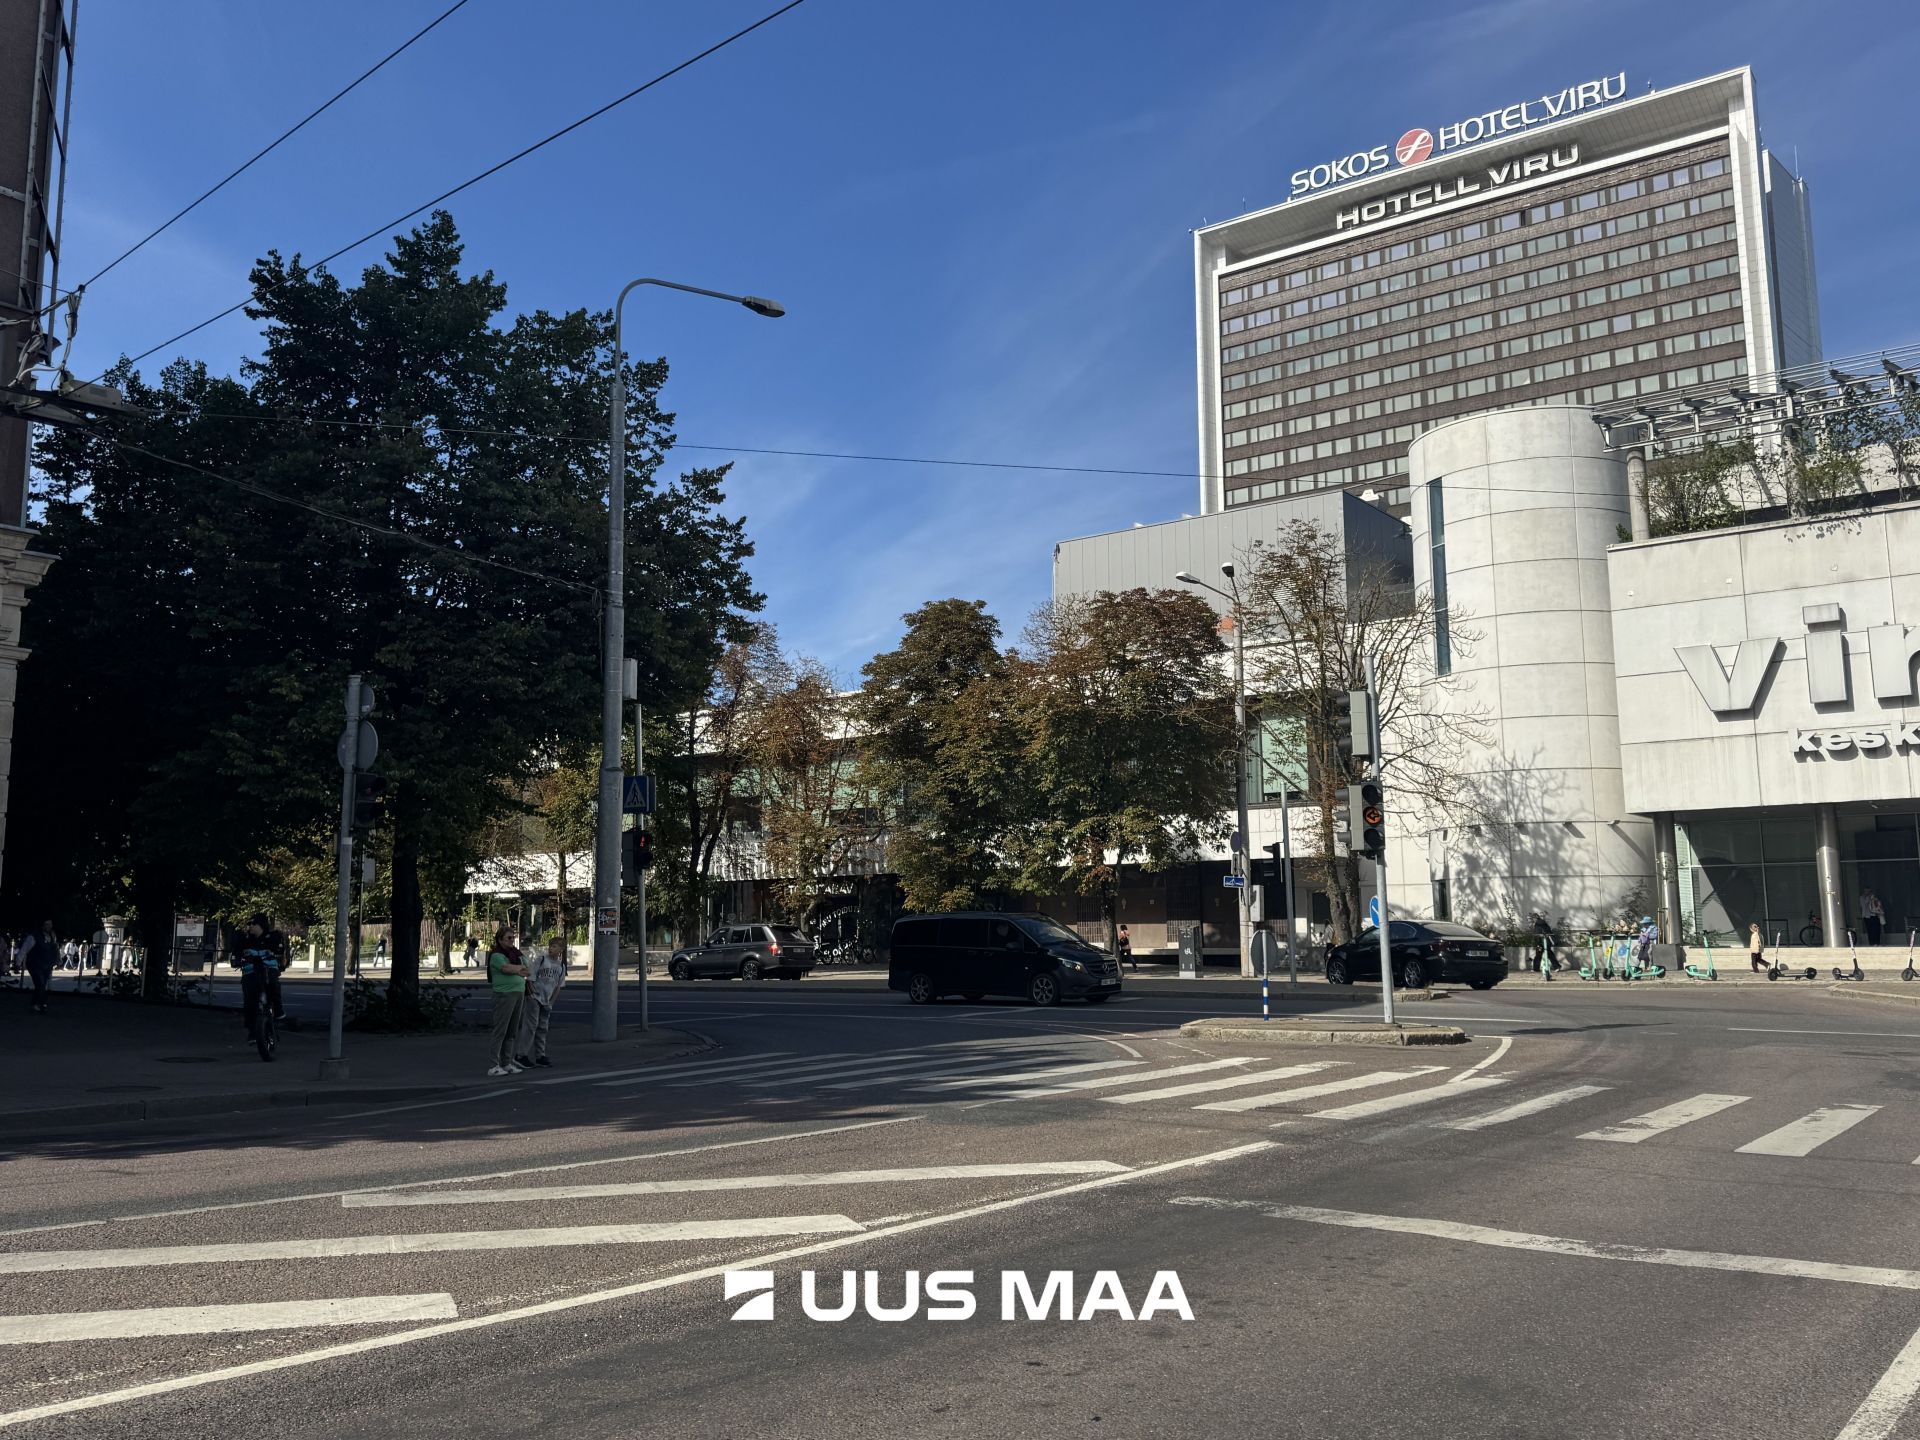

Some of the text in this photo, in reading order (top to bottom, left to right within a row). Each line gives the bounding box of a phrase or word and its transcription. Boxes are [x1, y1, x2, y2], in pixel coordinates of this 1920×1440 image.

[1291, 71, 1626, 195] SOKOS HOTEL VIRU
[1336, 143, 1579, 230] HOTELL VIRU
